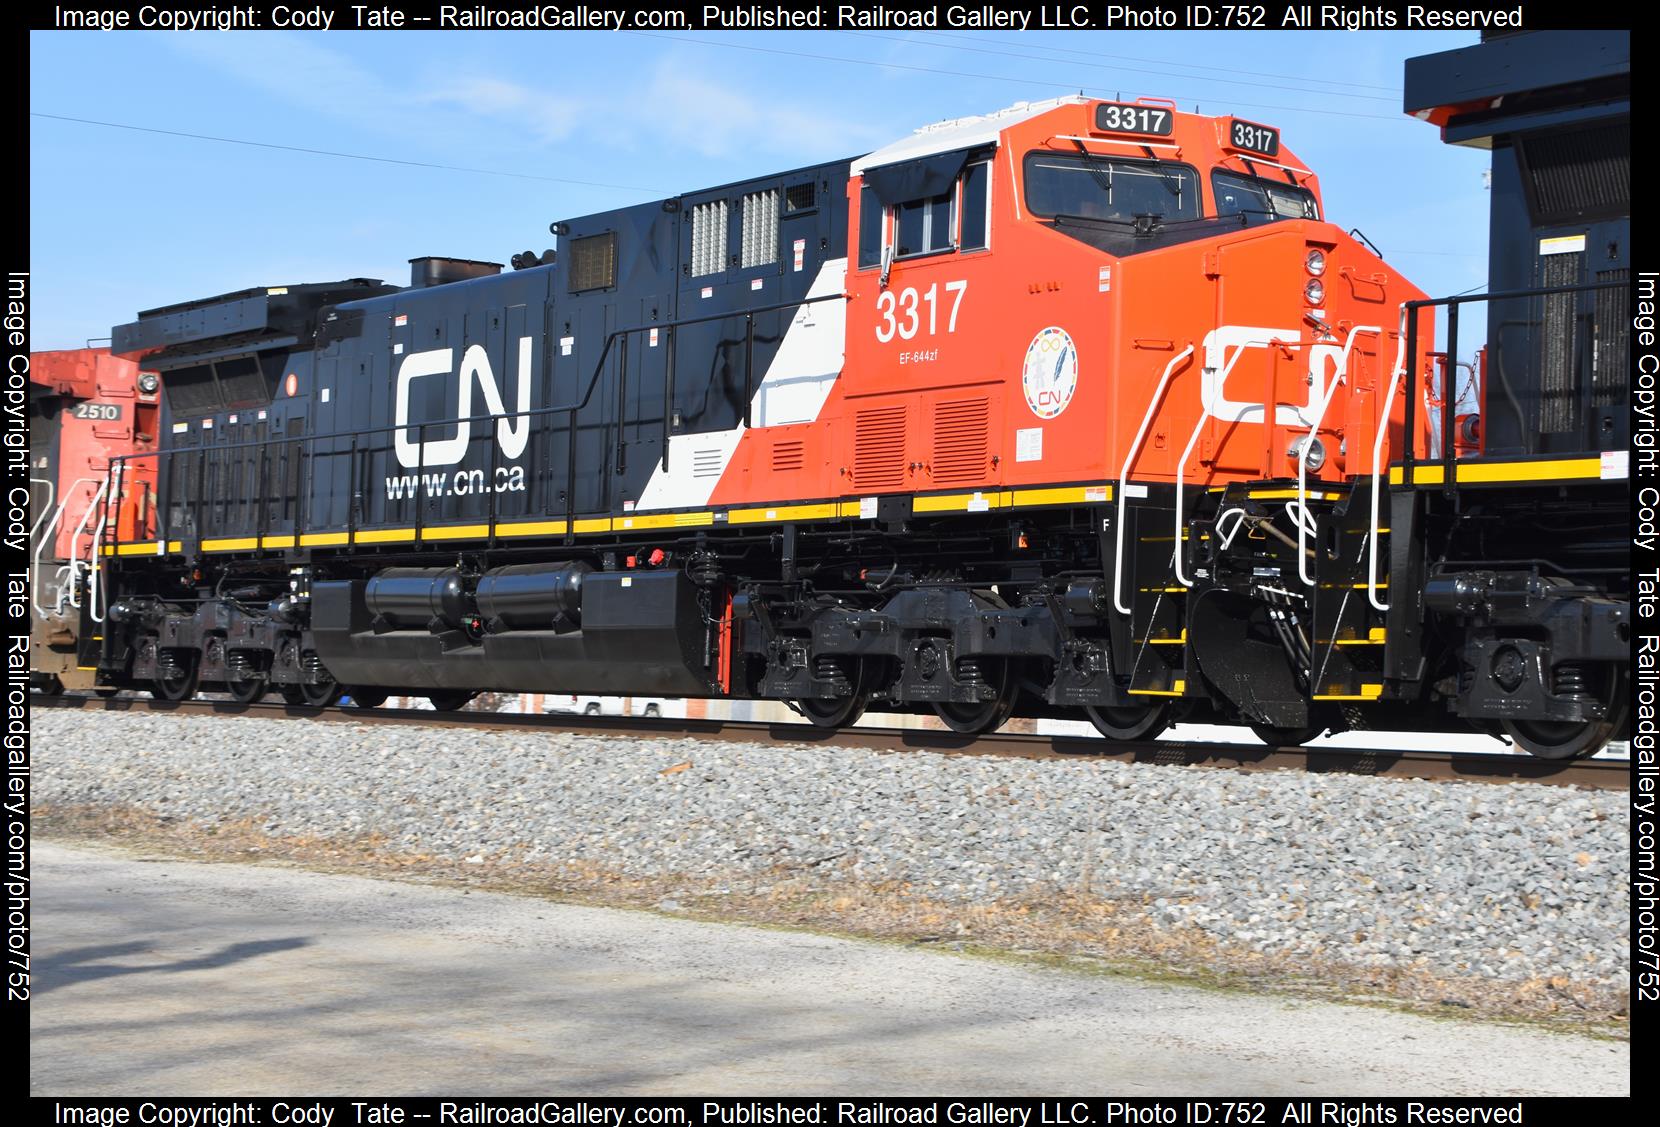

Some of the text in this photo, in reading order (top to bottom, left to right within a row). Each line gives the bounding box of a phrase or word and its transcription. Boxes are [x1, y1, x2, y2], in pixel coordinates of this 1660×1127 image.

[1106, 106, 1166, 132] 3317
[1235, 123, 1272, 151] 3317
[875, 279, 967, 343] 3317
[899, 349, 938, 364] EF-644zf
[395, 336, 532, 468] CN
[1038, 390, 1061, 406] CN
[77, 404, 118, 420] 2510
[1103, 518, 1110, 532] F
